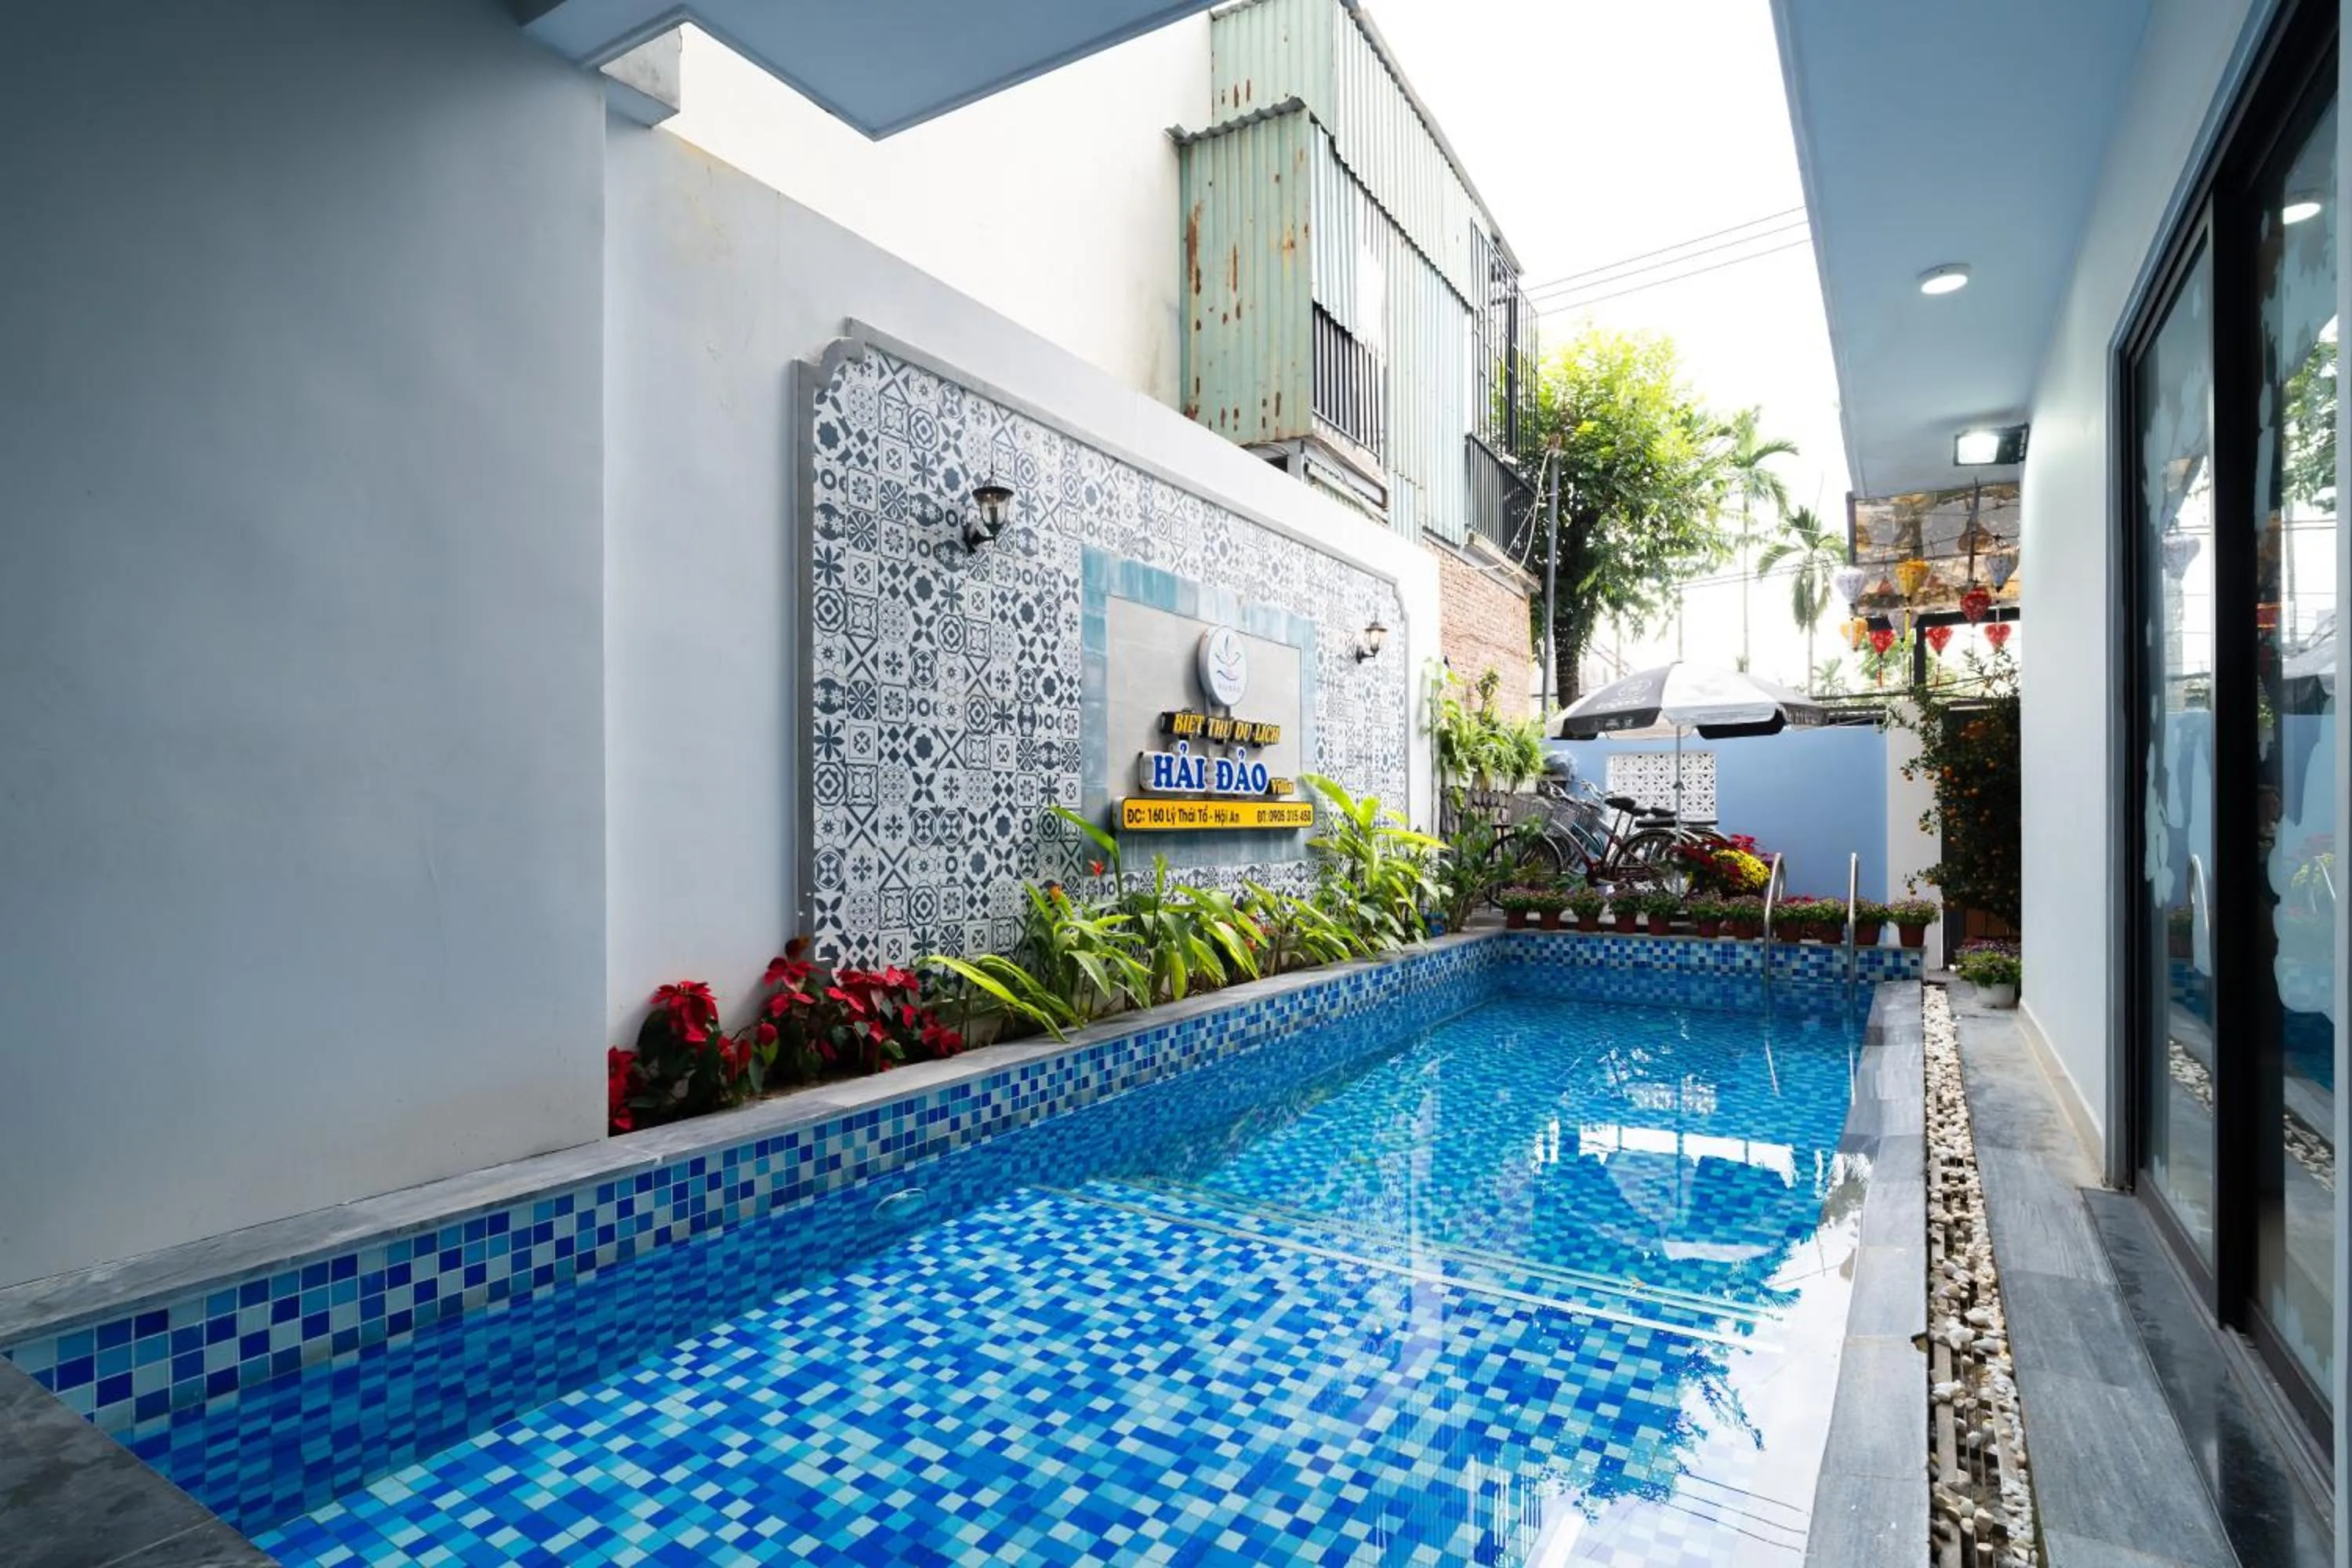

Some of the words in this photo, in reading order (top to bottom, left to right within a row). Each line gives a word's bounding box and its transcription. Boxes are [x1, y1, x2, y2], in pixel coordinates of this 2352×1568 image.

[1234, 720, 1253, 742] DU
[1153, 742, 1205, 789] HẢI
[1215, 748, 1268, 793] ĐẢO
[1127, 808, 1145, 824] ĐC:
[1148, 808, 1164, 822] 160
[1166, 806, 1176, 826] Lý
